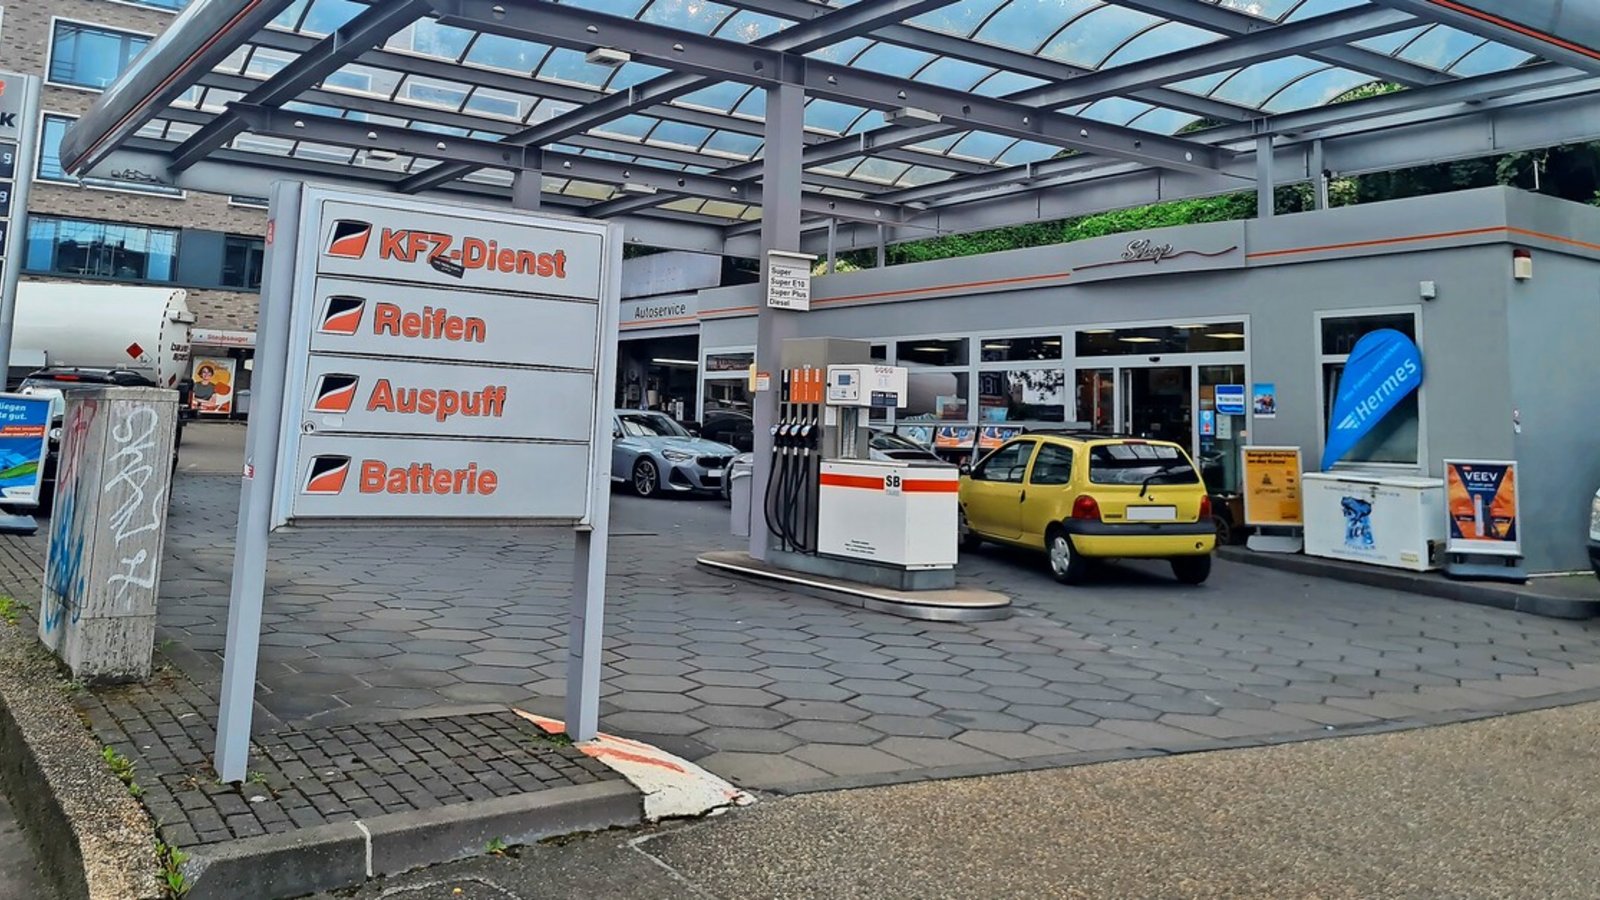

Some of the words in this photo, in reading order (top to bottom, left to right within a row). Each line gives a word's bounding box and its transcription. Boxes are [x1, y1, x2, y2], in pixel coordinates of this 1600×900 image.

[379, 228, 567, 278] KFZ-Dienst
[1121, 239, 1174, 264] Shop
[770, 266, 792, 276] Super
[770, 277, 791, 287] Super
[792, 279, 805, 288] E10
[770, 287, 791, 297] Super
[792, 289, 807, 298] Plus
[769, 297, 791, 306] Diesel
[634, 303, 686, 319] Autoservice
[374, 302, 487, 343] Reifen
[1354, 357, 1417, 422] Hermes
[366, 378, 507, 422] Auspuff
[359, 459, 498, 496] Batterie
[885, 475, 901, 488] SB
[1463, 471, 1499, 482] VEEV
